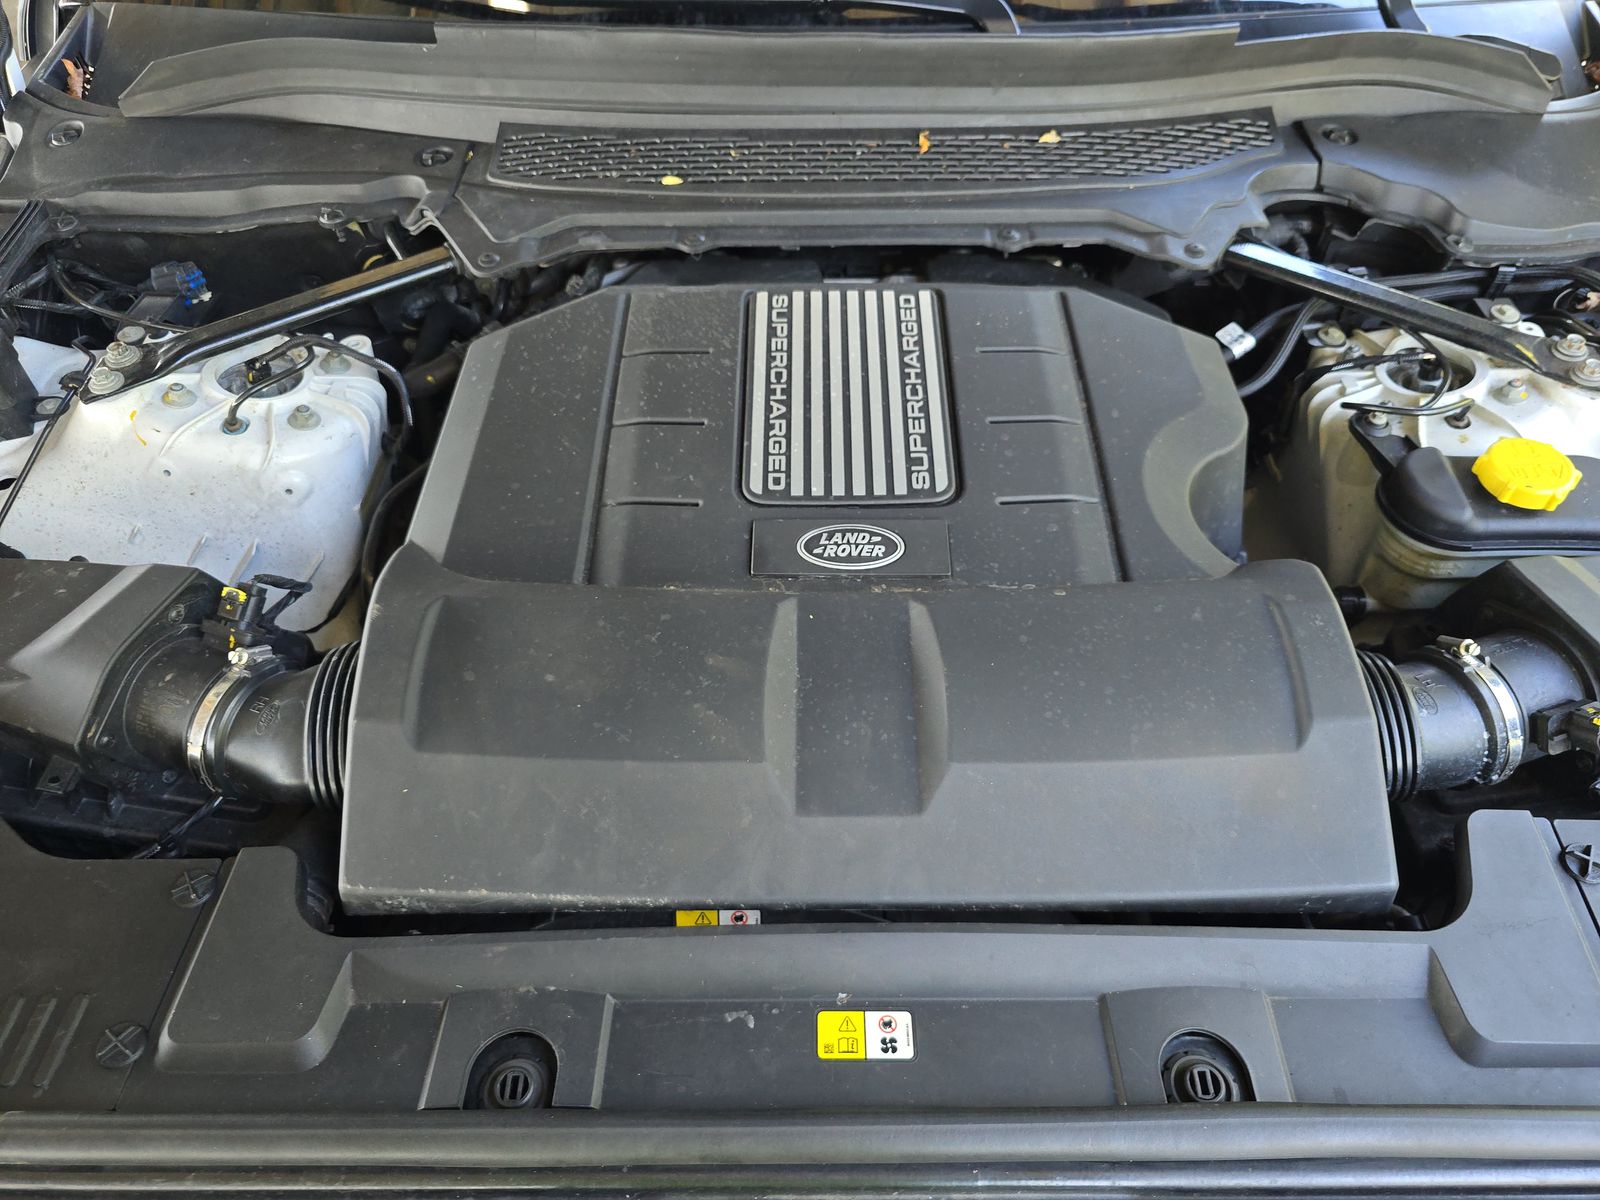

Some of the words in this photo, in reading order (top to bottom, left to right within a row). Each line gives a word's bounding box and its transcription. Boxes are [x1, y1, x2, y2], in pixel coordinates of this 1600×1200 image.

[768, 294, 788, 491] SUPERCHARGED
[899, 294, 930, 490] SUPERCHARGED
[823, 544, 885, 557] ROVER
[249, 695, 270, 714] RH
